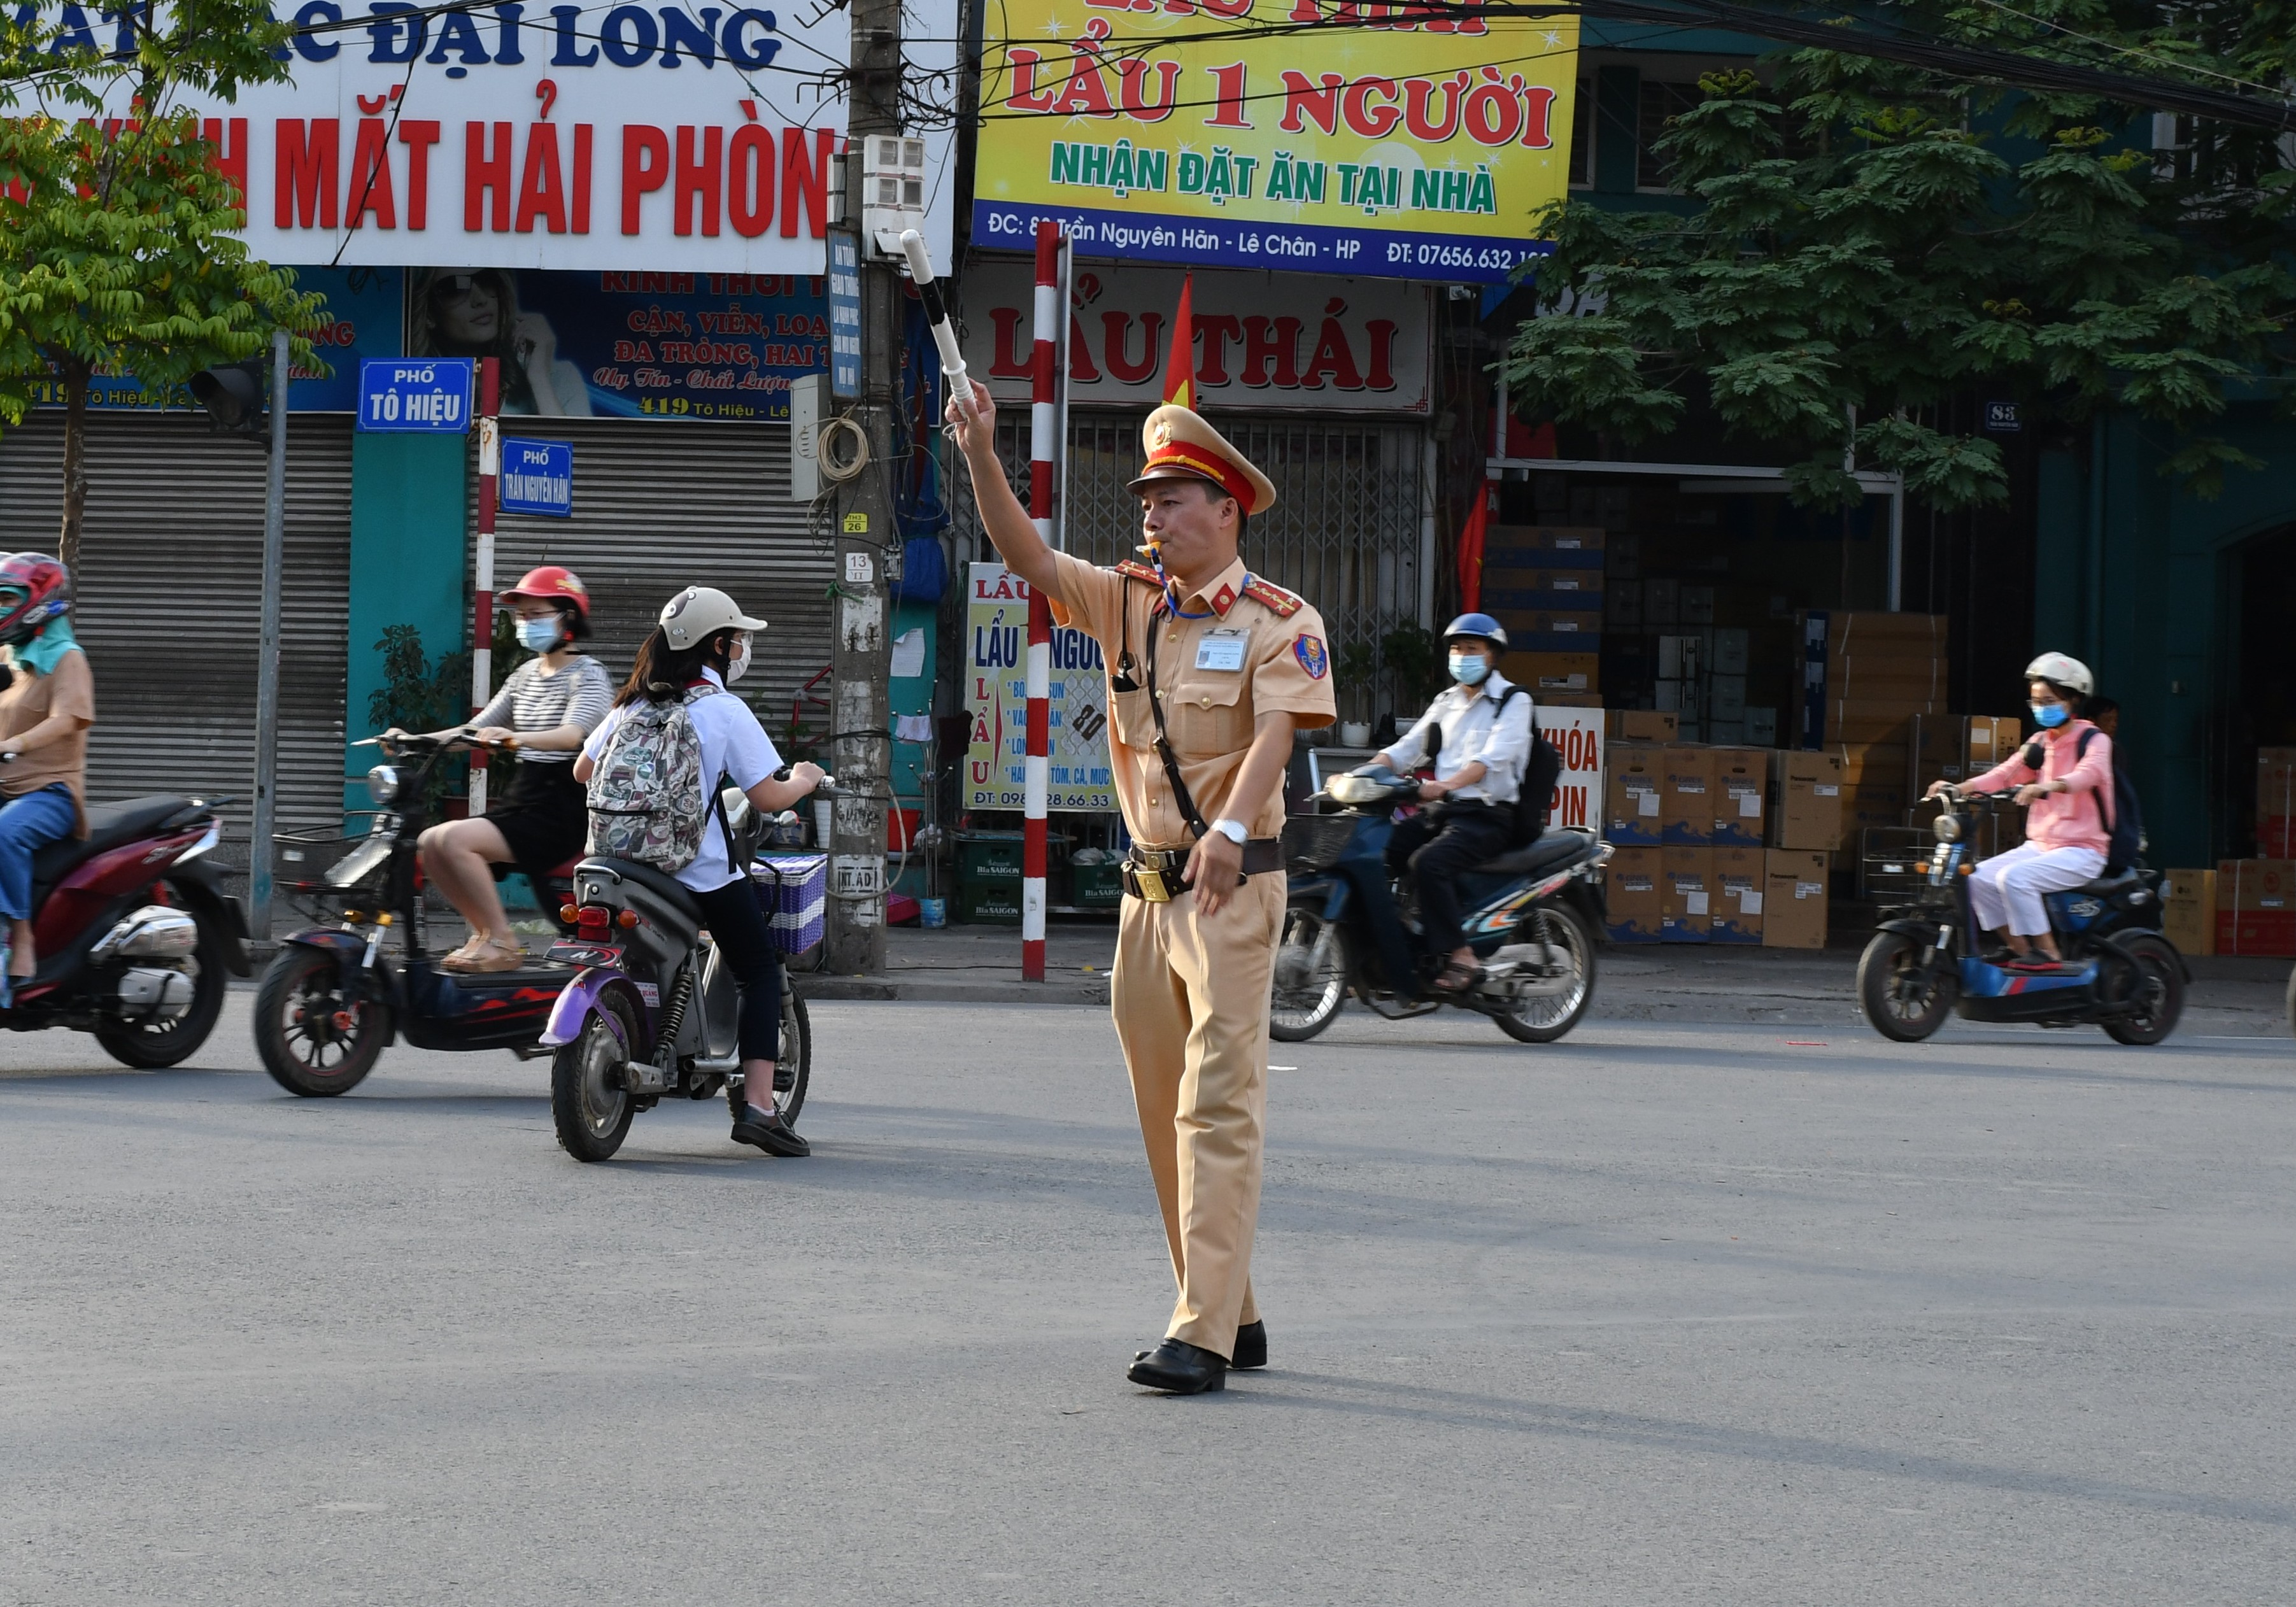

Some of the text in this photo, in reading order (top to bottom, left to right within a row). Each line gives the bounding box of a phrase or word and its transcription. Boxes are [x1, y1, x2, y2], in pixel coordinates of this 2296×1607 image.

[367, 2, 525, 78] ĐẠI
[550, 5, 783, 71] LONG
[1005, 17, 1557, 150] LẨU 1 NGƯỜI
[274, 84, 441, 230] MẮT
[464, 79, 593, 234] HẢI
[621, 99, 848, 239] PHÒN
[1050, 138, 1496, 216] NHẬN ĐẶT ĂN TẠI NHÀ
[988, 213, 1361, 260] ĐC: 8 Trần Nguyên Hãn Lê Chân HP
[1387, 243, 1550, 270] ĐT: 07656.632.1
[627, 304, 692, 337] CẬN,
[697, 302, 770, 339] VIỄN,
[615, 340, 655, 362] ĐA
[765, 344, 814, 367] HAI
[1192, 297, 1397, 391] THÁI
[394, 364, 437, 383] PHỐ
[593, 367, 630, 390] Uy
[634, 367, 672, 388] Tín
[686, 369, 735, 389] Chất
[370, 388, 460, 427] TÔ HIỆU
[639, 397, 789, 419] 419 Tô Hiệu Lê
[523, 446, 550, 465] PHỐ
[525, 471, 552, 503] NGUYÊN
[847, 523, 861, 531] 26
[851, 555, 867, 567] 13
[975, 609, 1019, 669] LẨU
[1051, 764, 1071, 786] TÔM,
[1074, 764, 1088, 786] CÁ,
[1090, 767, 1110, 789] MỰC
[974, 792, 995, 804] ĐT:
[1545, 786, 1587, 826] PIN
